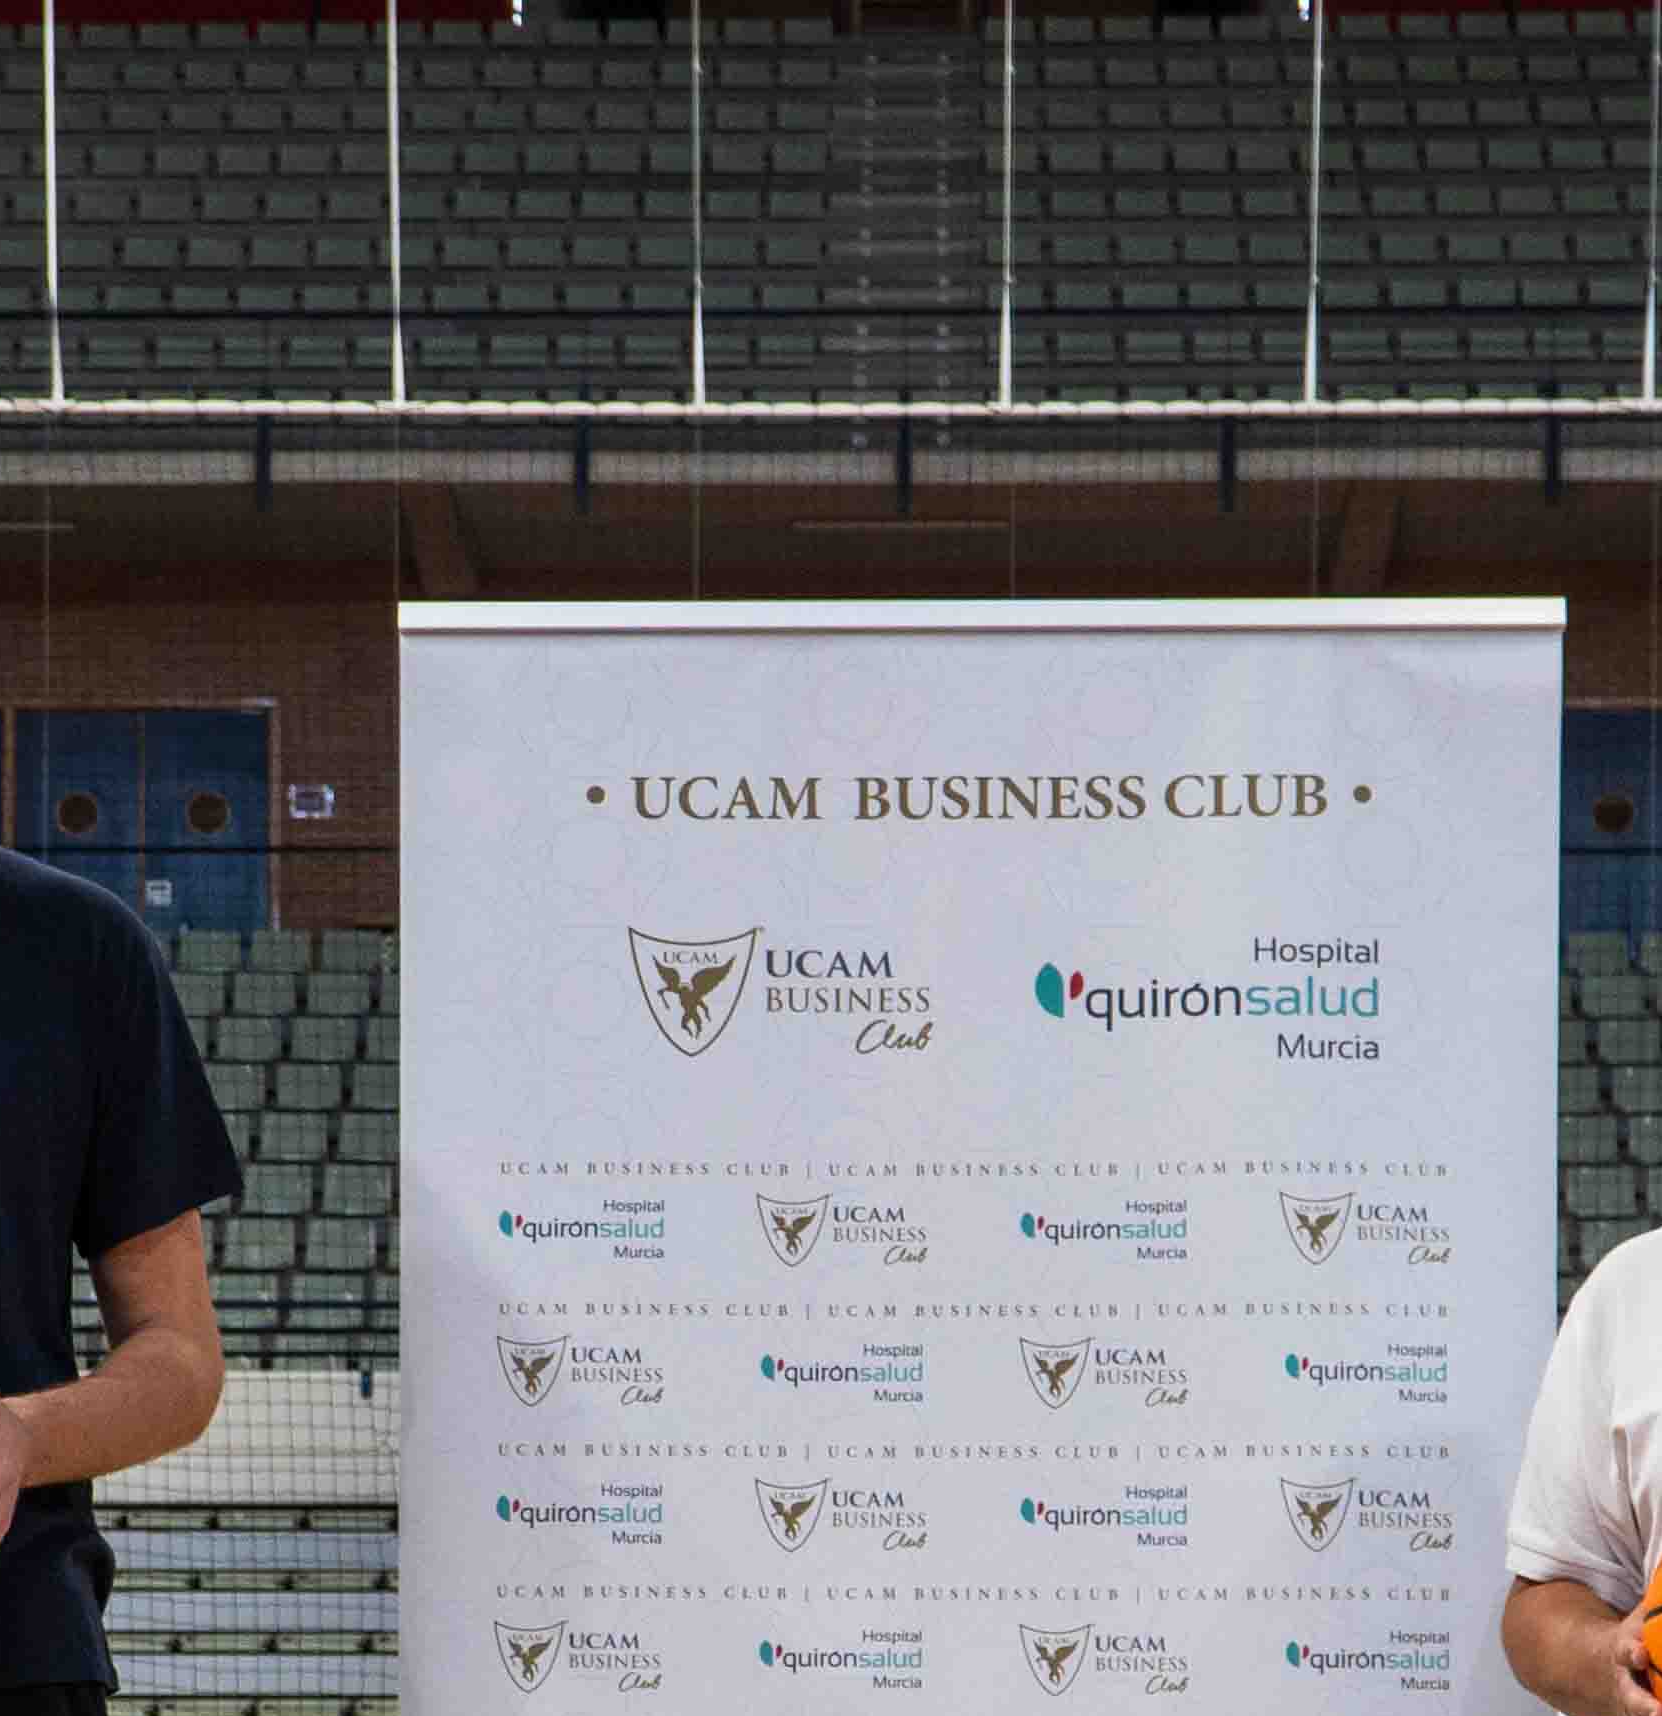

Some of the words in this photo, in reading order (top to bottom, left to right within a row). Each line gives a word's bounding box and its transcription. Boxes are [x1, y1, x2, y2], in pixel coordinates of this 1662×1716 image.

[631, 775, 823, 821] UCAM
[854, 774, 1147, 821] BUSINESS
[1164, 772, 1329, 818] CLUB
[662, 951, 719, 965] UCAM
[1253, 936, 1379, 968] Hospital
[765, 949, 894, 979] UCAM
[765, 986, 931, 1013] BUSINESS
[1085, 975, 1379, 1033] quirónsalud
[854, 1019, 935, 1055] Club
[1276, 1033, 1380, 1060] Murcia
[501, 1162, 570, 1176] UCAM
[587, 1161, 710, 1175] BUSINESS
[725, 1162, 790, 1176] CLUB
[829, 1163, 898, 1177] UCAM
[916, 1162, 1039, 1176] BUSINESS
[1054, 1162, 1119, 1177] CLUB
[1158, 1161, 1227, 1176] UCAM
[1245, 1160, 1369, 1175] BUSINESS
[1383, 1162, 1448, 1177] CLUB
[603, 1199, 665, 1215] Hospital
[834, 1206, 906, 1224] UCAM
[1124, 1199, 1187, 1215] Hospital
[1356, 1204, 1429, 1222] UCAM
[833, 1226, 926, 1243] BUSINESS
[1356, 1226, 1450, 1242] BUSINESS
[614, 1245, 665, 1259] Murcia
[1136, 1245, 1187, 1259] Murcia
[571, 1347, 642, 1364] UCAM
[862, 1343, 923, 1358] Hospital
[1095, 1348, 1166, 1366] UCAM
[1387, 1343, 1448, 1358] Hospital
[571, 1368, 663, 1384] BUSINESS
[1095, 1369, 1188, 1385] BUSINESS
[874, 1388, 923, 1402] Murcia
[1399, 1389, 1449, 1403] Murcia
[496, 1585, 566, 1599] UCAM
[583, 1585, 708, 1600] BUSINESS
[723, 1585, 788, 1600] CLUB
[826, 1586, 896, 1600] UCAM
[914, 1586, 1038, 1601] BUSINESS
[1054, 1587, 1120, 1601] CLUB
[1159, 1587, 1228, 1602] UCAM
[1246, 1586, 1371, 1601] BUSINESS
[1386, 1587, 1451, 1602] CLUB
[569, 1632, 640, 1650] UCAM
[862, 1629, 923, 1645] Hospital
[1095, 1634, 1166, 1653] UCAM
[1389, 1630, 1450, 1645] Hospital
[569, 1654, 661, 1670] BUSINESS
[1095, 1655, 1188, 1672] BUSINESS
[872, 1675, 922, 1689] Murcia
[1400, 1676, 1451, 1691] Murcia
